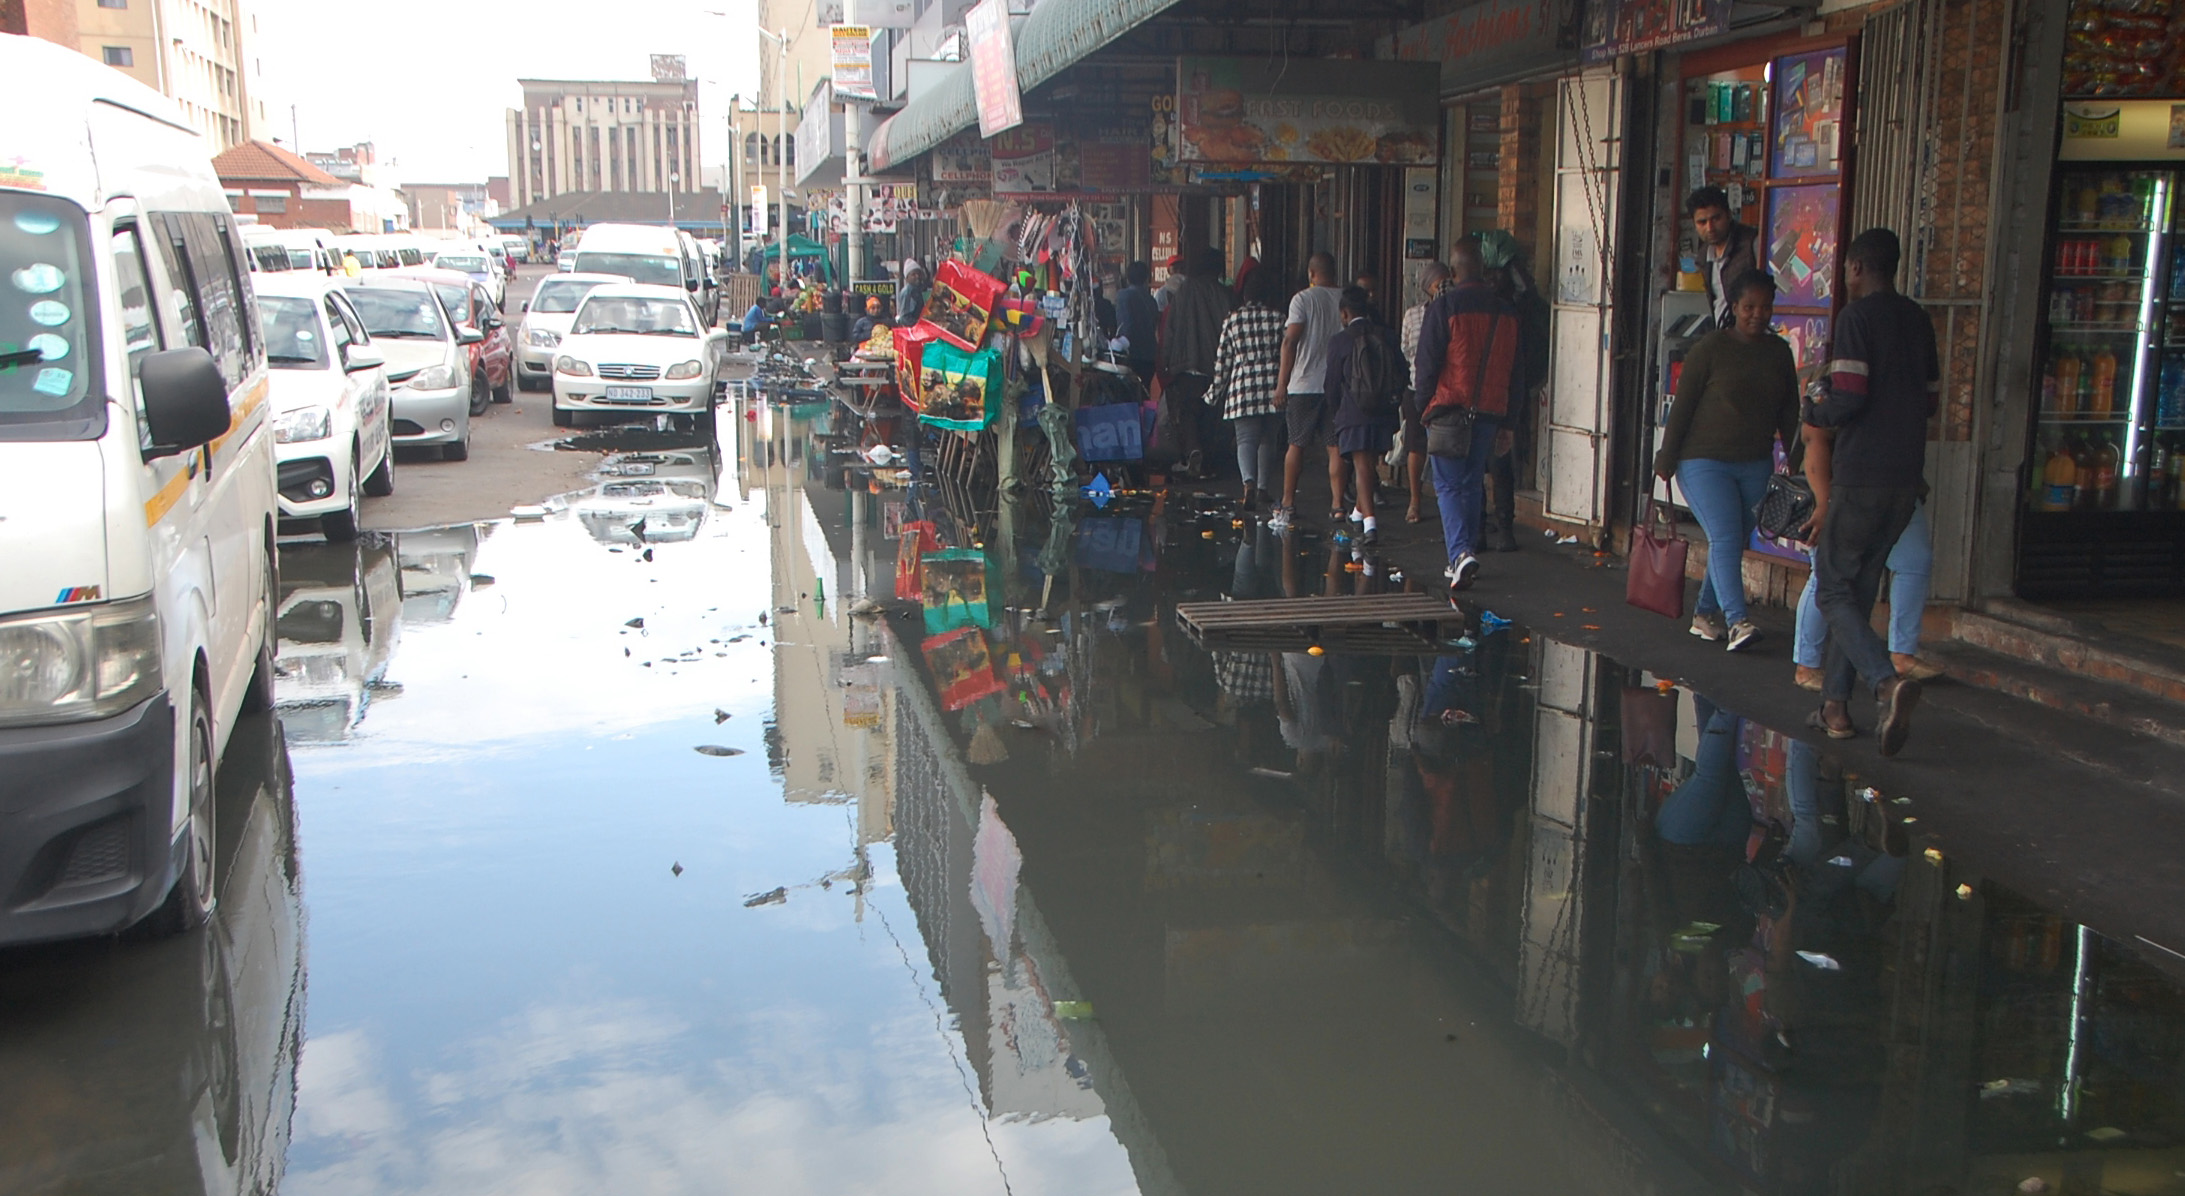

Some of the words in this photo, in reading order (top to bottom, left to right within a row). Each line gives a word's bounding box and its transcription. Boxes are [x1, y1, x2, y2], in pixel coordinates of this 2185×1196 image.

[1592, 48, 1606, 60] Shop
[1630, 39, 1653, 52] Lancers
[1654, 35, 1670, 47] Road
[1694, 25, 1717, 39] Durban
[1246, 99, 1305, 119] FAST
[1311, 99, 1398, 121] FOODS
[855, 284, 871, 294] CASH
[878, 283, 894, 294] GOLD
[608, 388, 618, 398] ND
